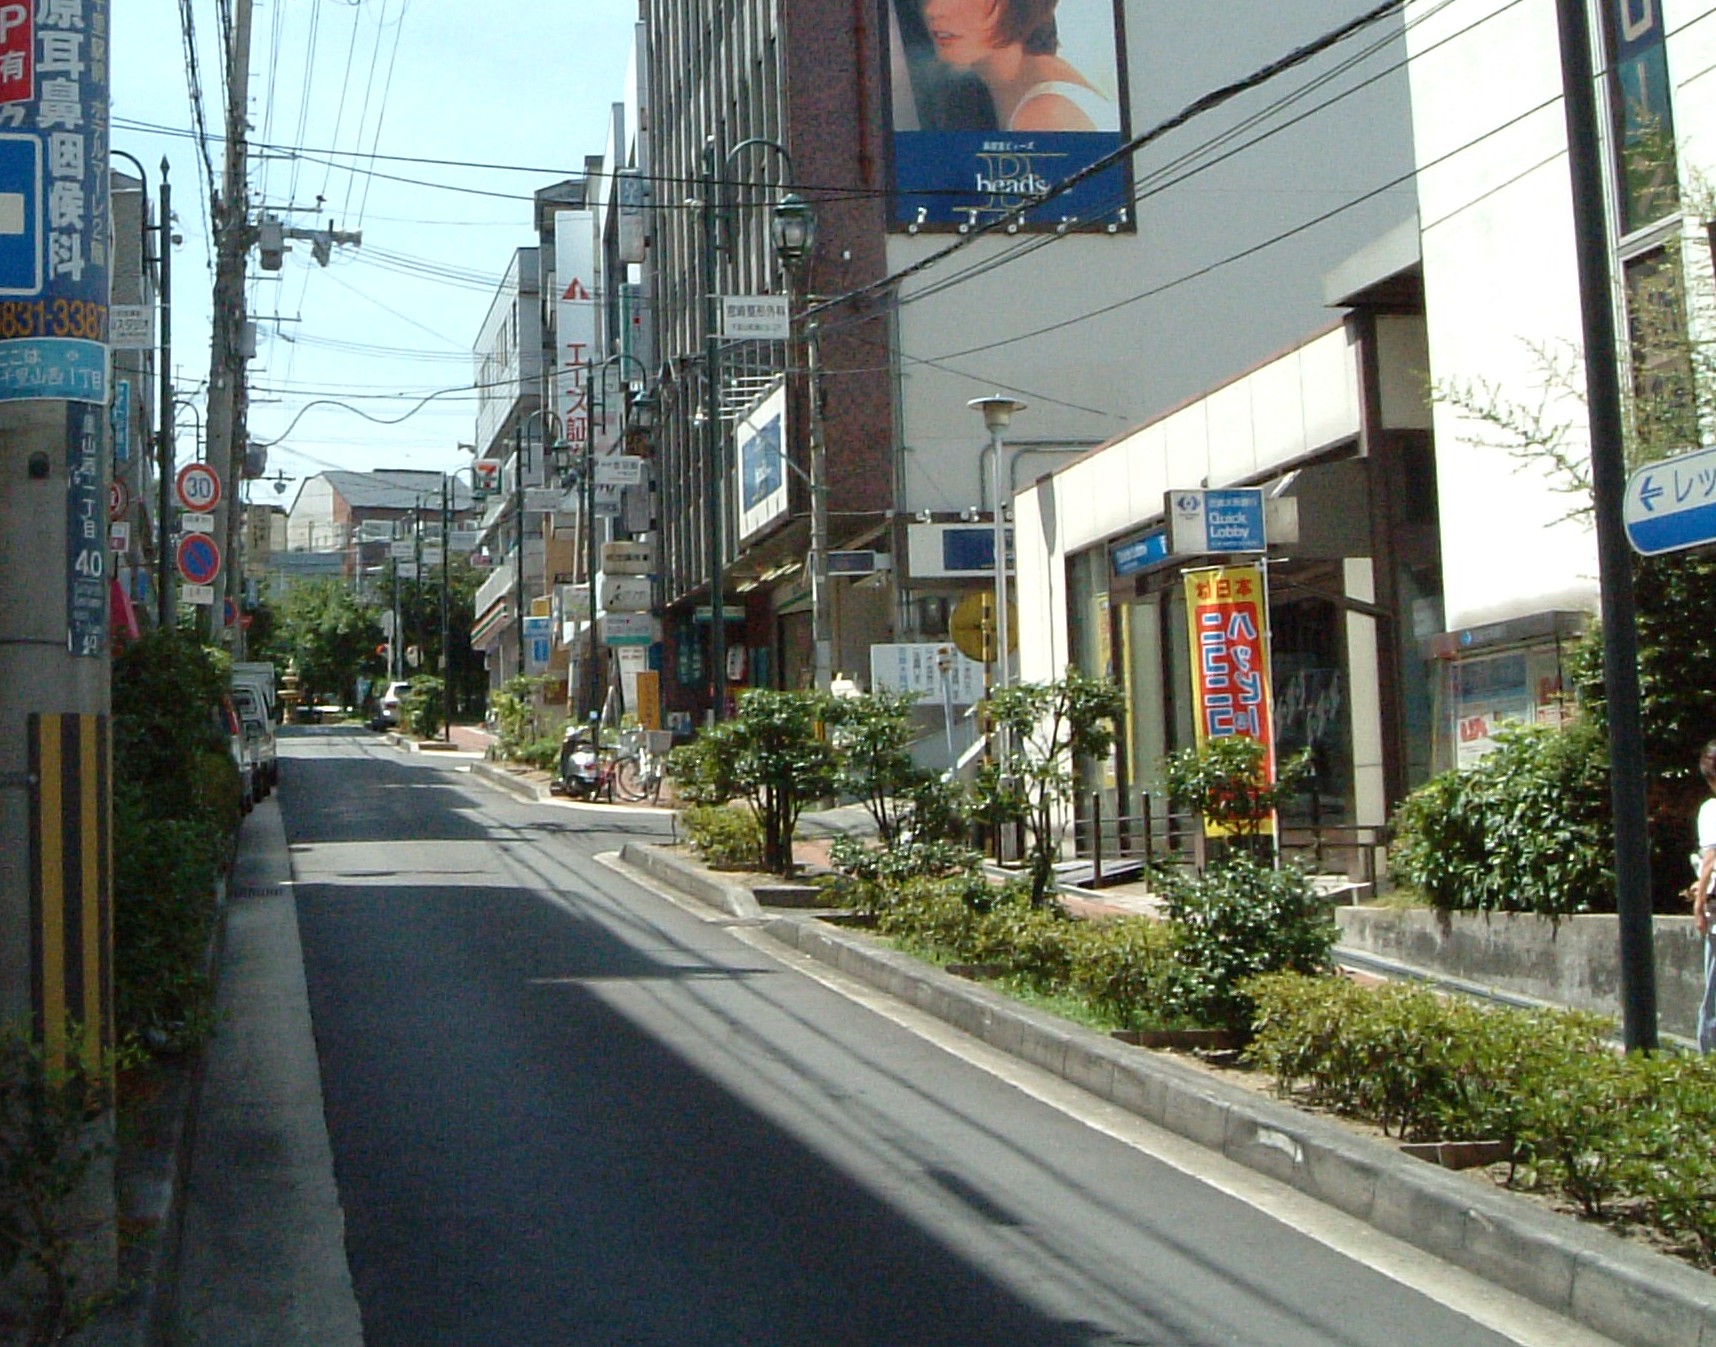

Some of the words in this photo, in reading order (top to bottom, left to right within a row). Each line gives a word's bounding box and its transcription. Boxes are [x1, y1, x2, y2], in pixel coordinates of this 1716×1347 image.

[976, 173, 1051, 194] beads
[187, 476, 212, 499] 30
[1208, 511, 1248, 524] Quick
[1210, 525, 1250, 539] Lobby
[75, 549, 102, 577] 40
